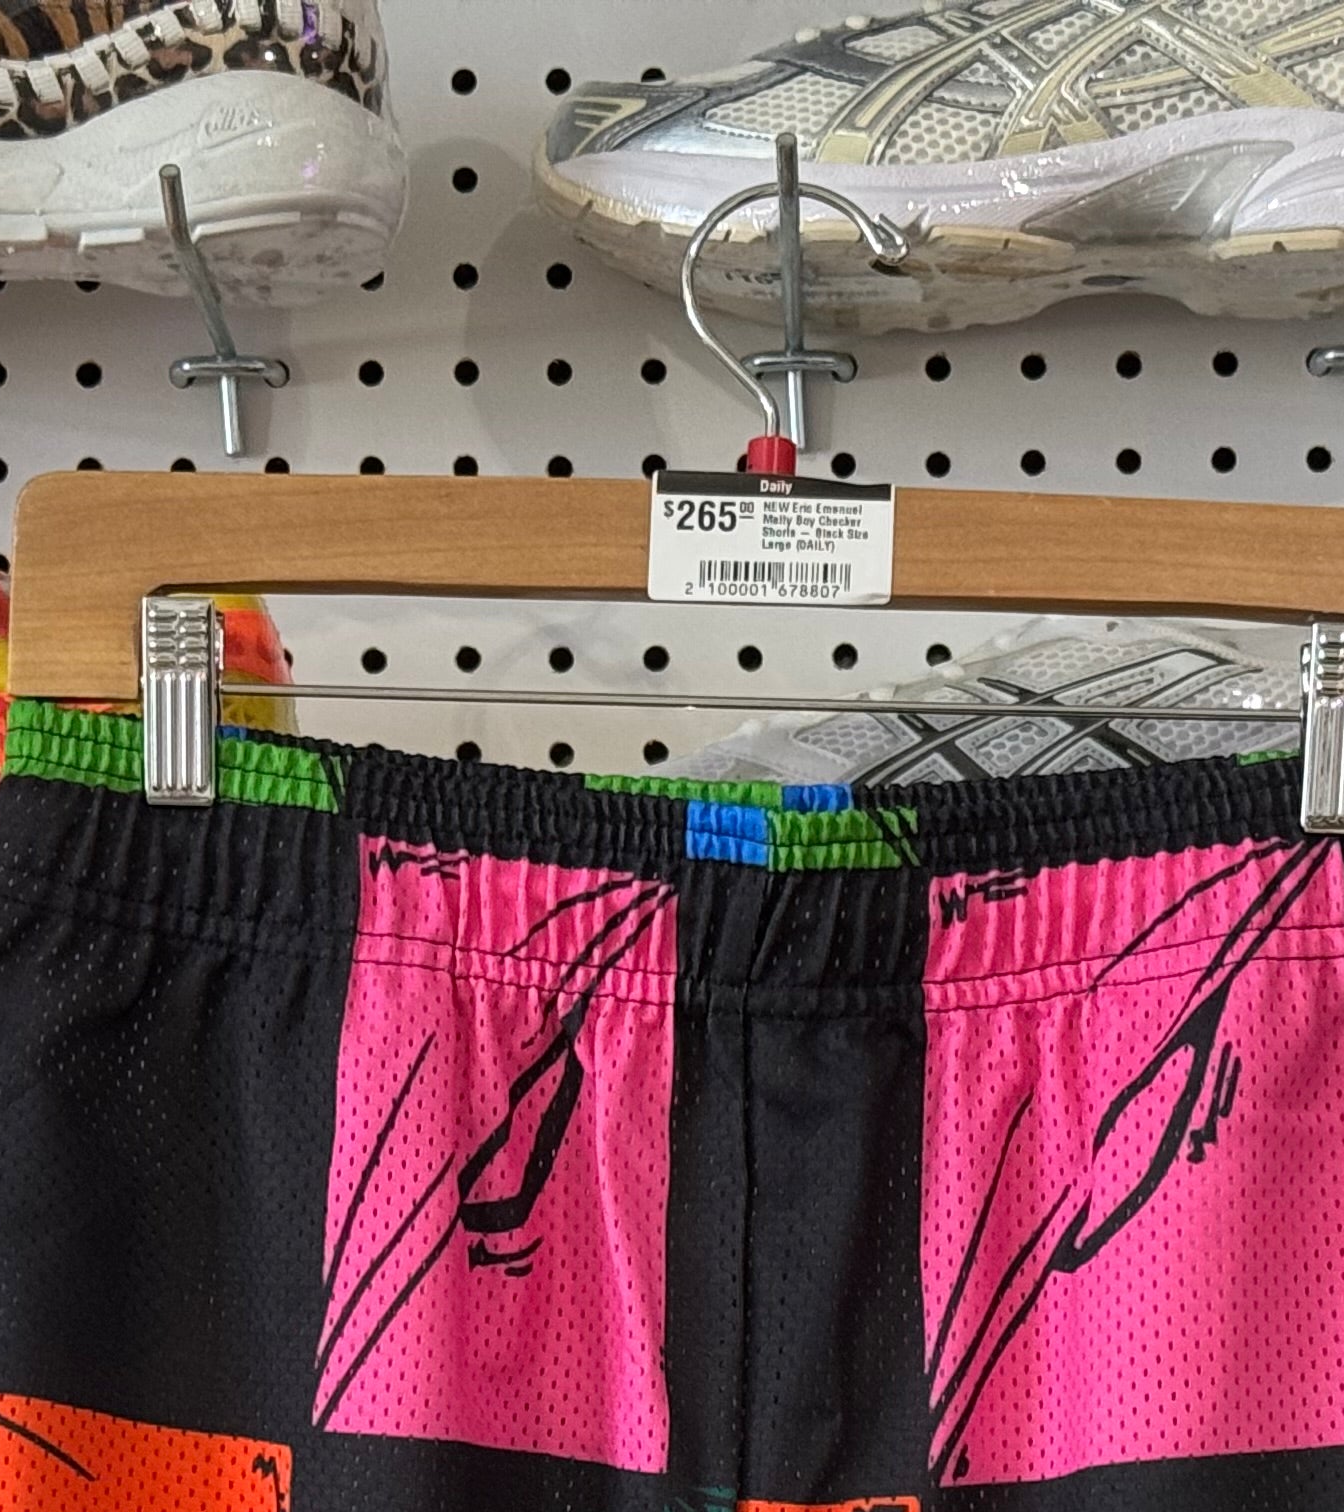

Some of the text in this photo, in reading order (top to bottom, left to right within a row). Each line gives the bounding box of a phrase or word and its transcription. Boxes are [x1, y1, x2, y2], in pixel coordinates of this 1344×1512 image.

[759, 479, 793, 495] Daily
[763, 501, 863, 515] NEW Eric Emanuel
[796, 515, 816, 529] Boy
[818, 516, 862, 527] Checker
[762, 526, 796, 538] Shorts
[815, 528, 844, 539] Black
[846, 529, 869, 540] Size
[761, 538, 835, 554] Large (DAILY)
[684, 582, 840, 598] 2 100001 678807
